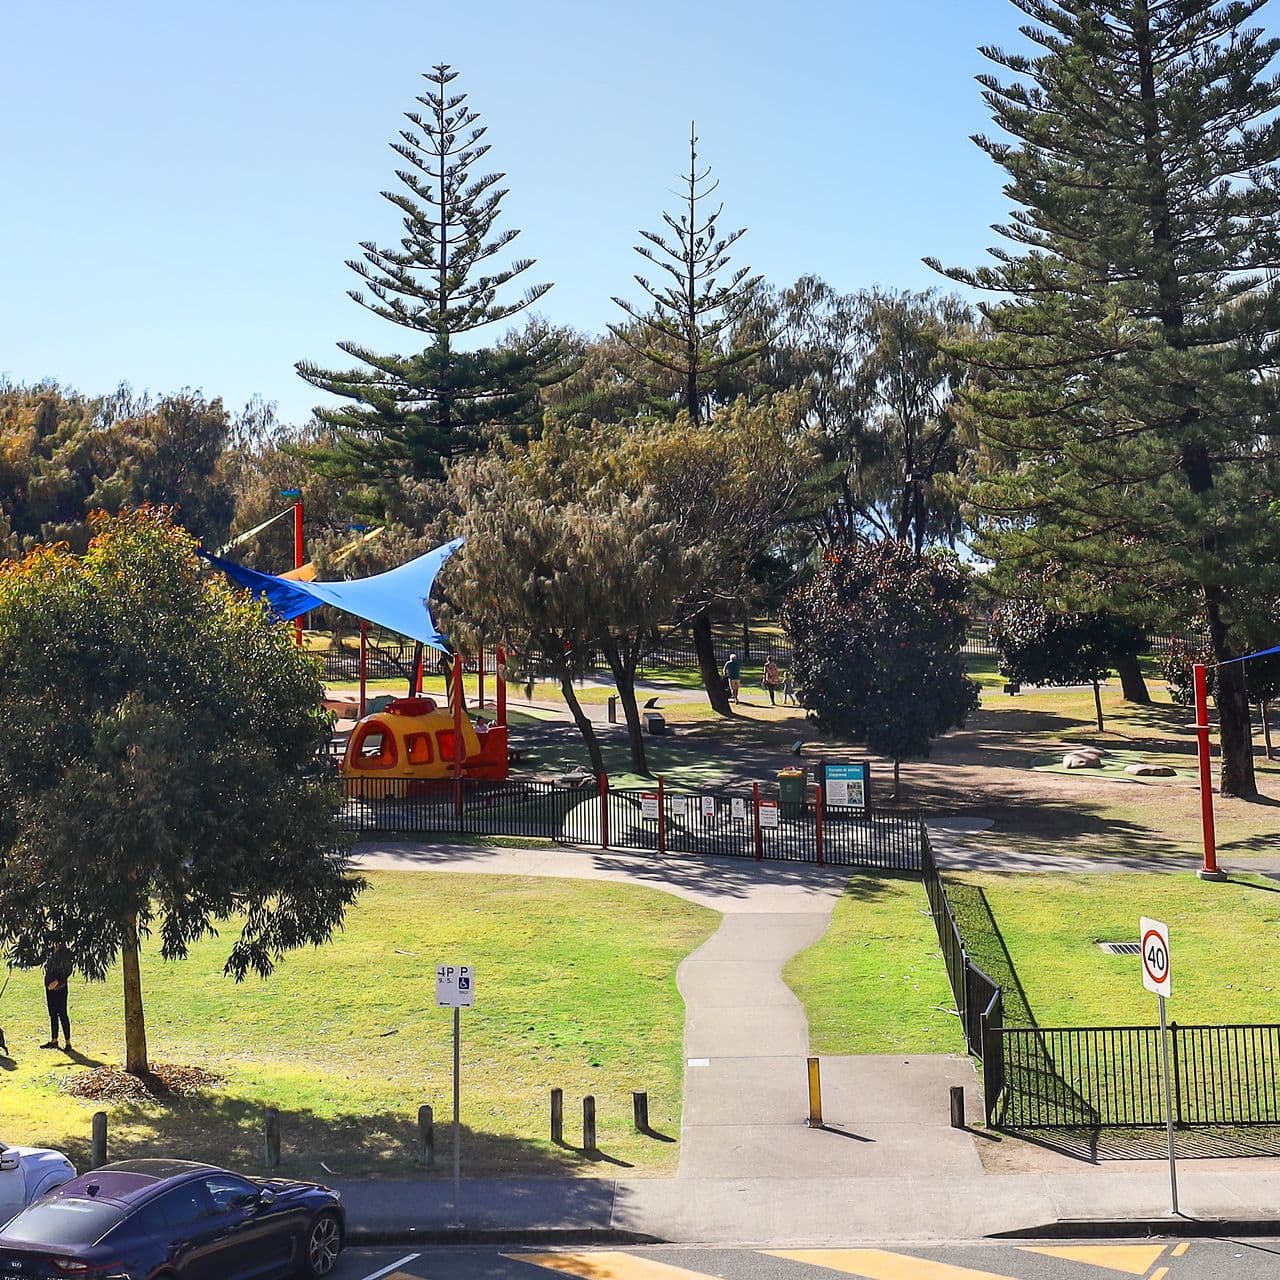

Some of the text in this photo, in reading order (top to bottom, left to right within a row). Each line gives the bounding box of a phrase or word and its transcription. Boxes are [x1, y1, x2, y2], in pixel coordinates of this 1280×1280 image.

[1147, 946, 1165, 971] 40
[437, 967, 454, 977] 4P
[460, 966, 468, 976] P
